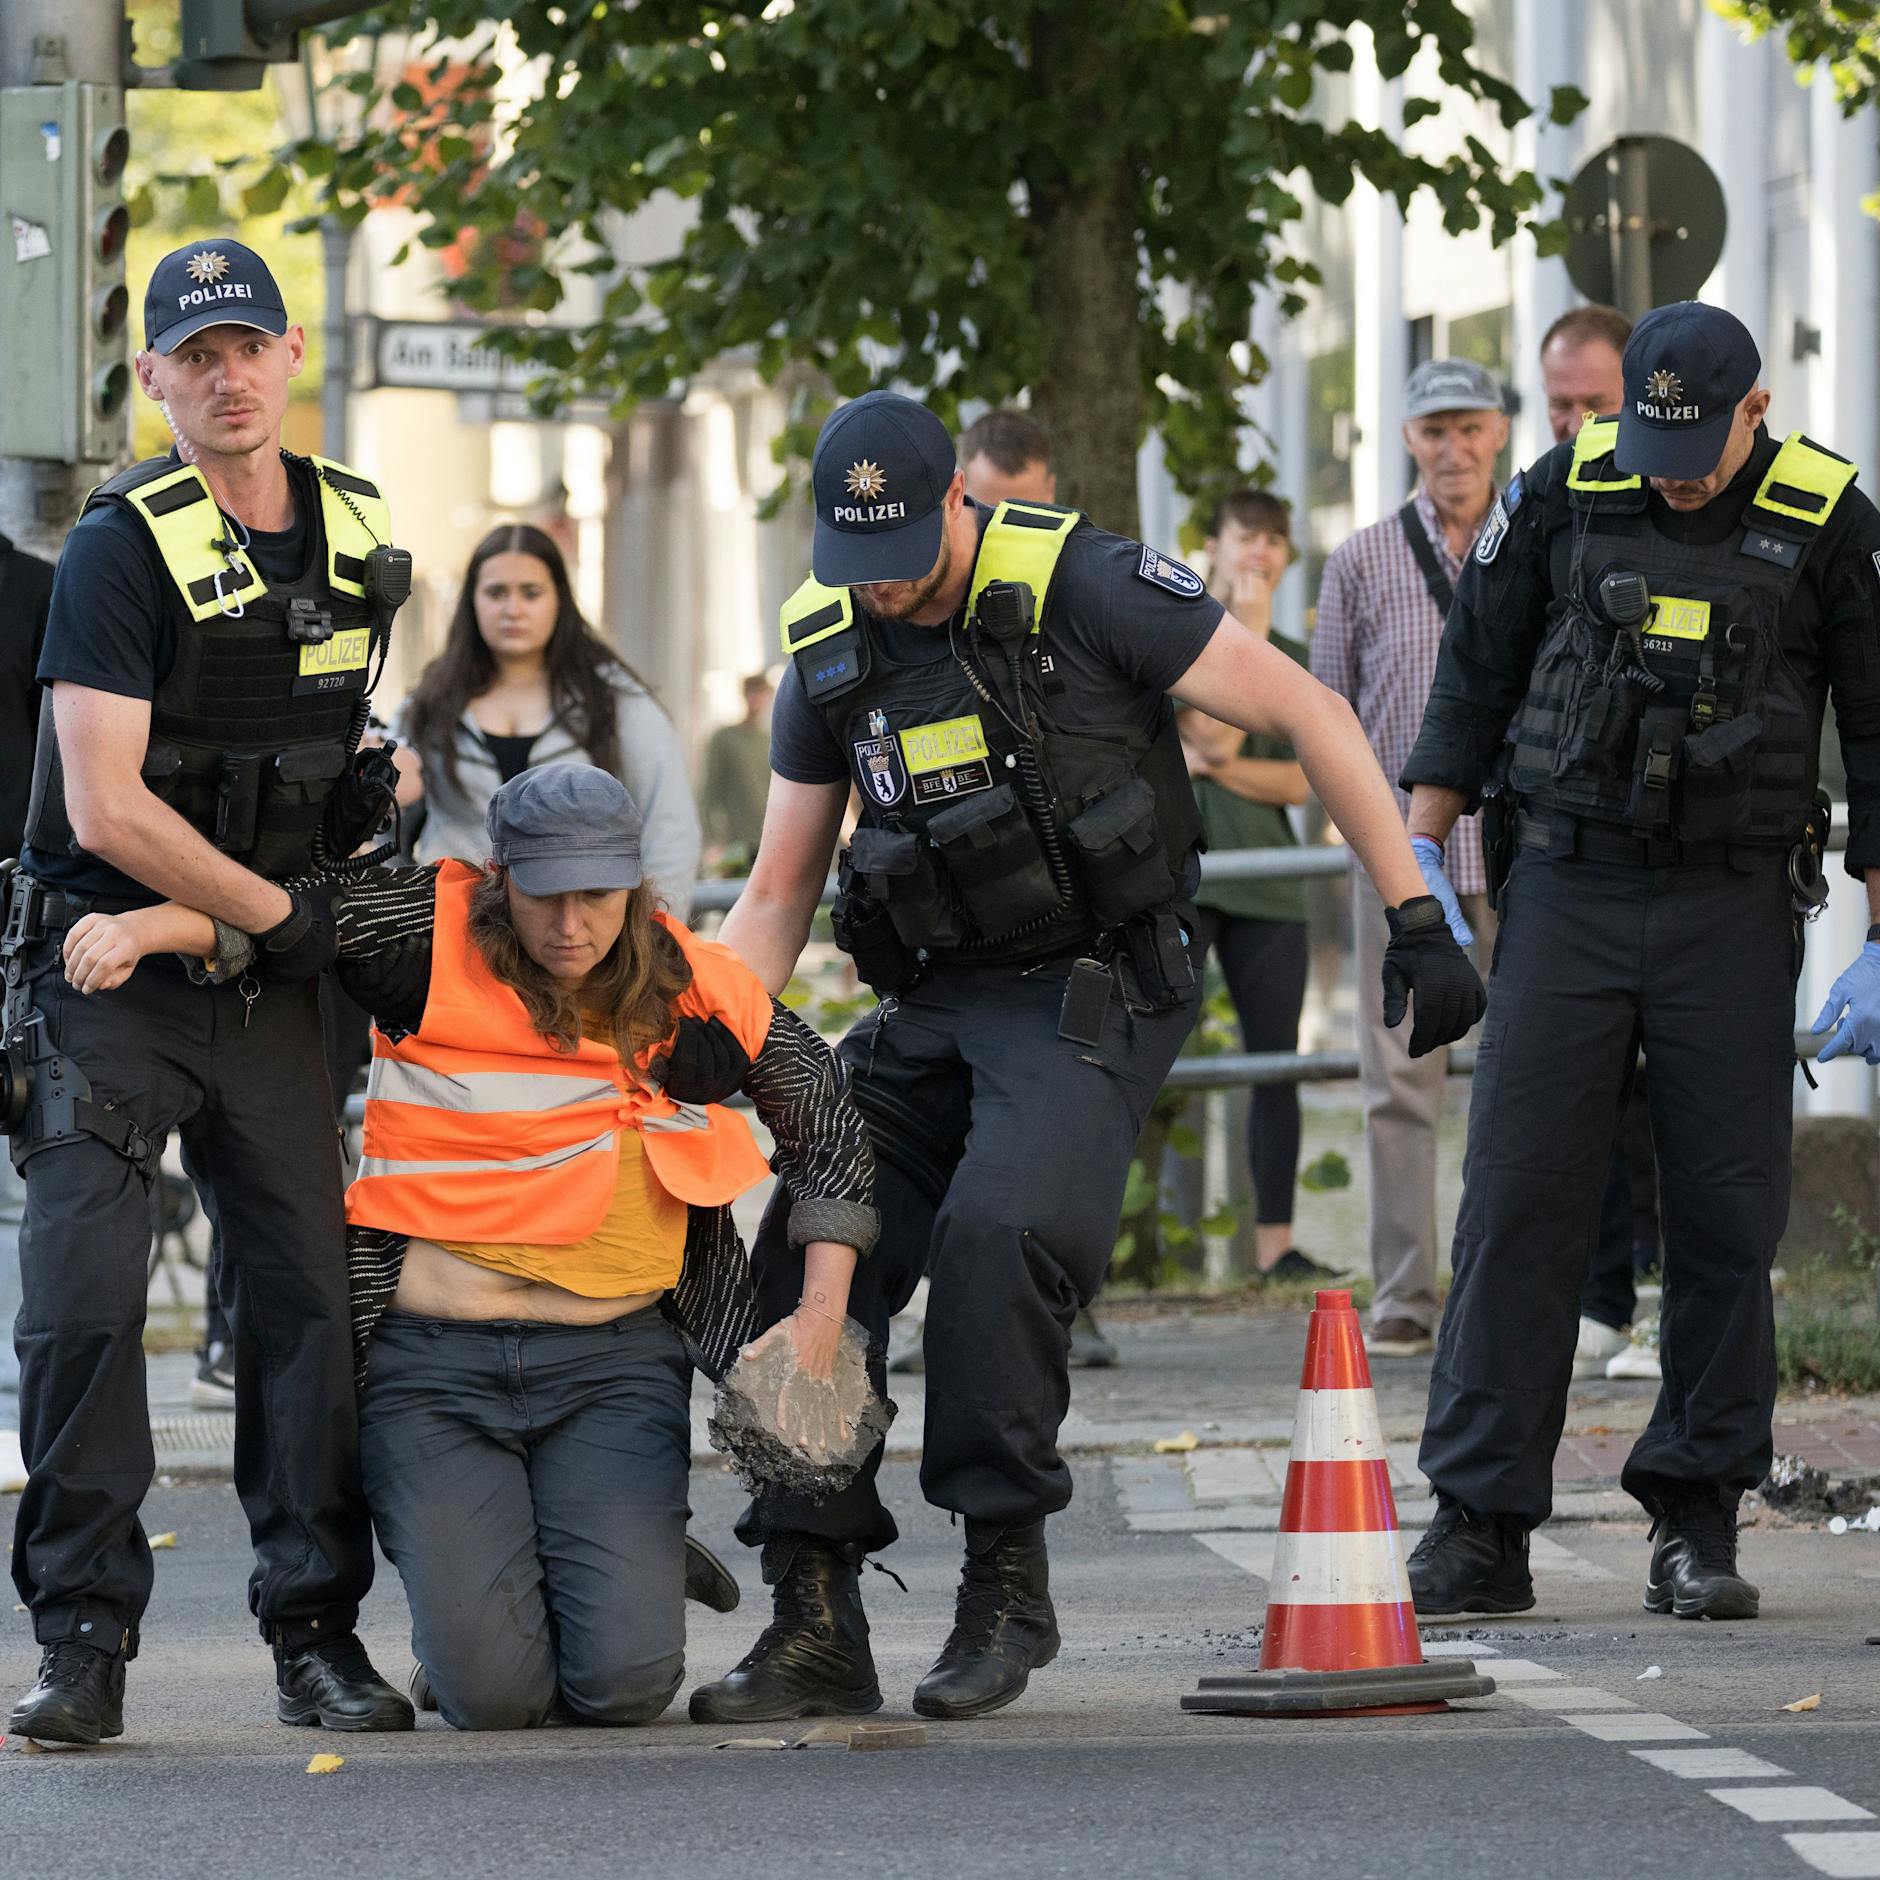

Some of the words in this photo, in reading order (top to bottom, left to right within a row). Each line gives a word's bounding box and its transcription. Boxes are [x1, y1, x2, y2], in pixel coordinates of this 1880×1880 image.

[178, 283, 253, 311] POLIZEI
[1636, 400, 1700, 421] POLIZEI
[833, 501, 906, 523] POLIZEI
[305, 636, 367, 668] POLIZEI
[1642, 638, 1673, 653] 56213
[317, 675, 345, 689] 92720
[907, 724, 982, 764] POLIZEI
[922, 779, 942, 791] BFE
[957, 772, 971, 783] BE
